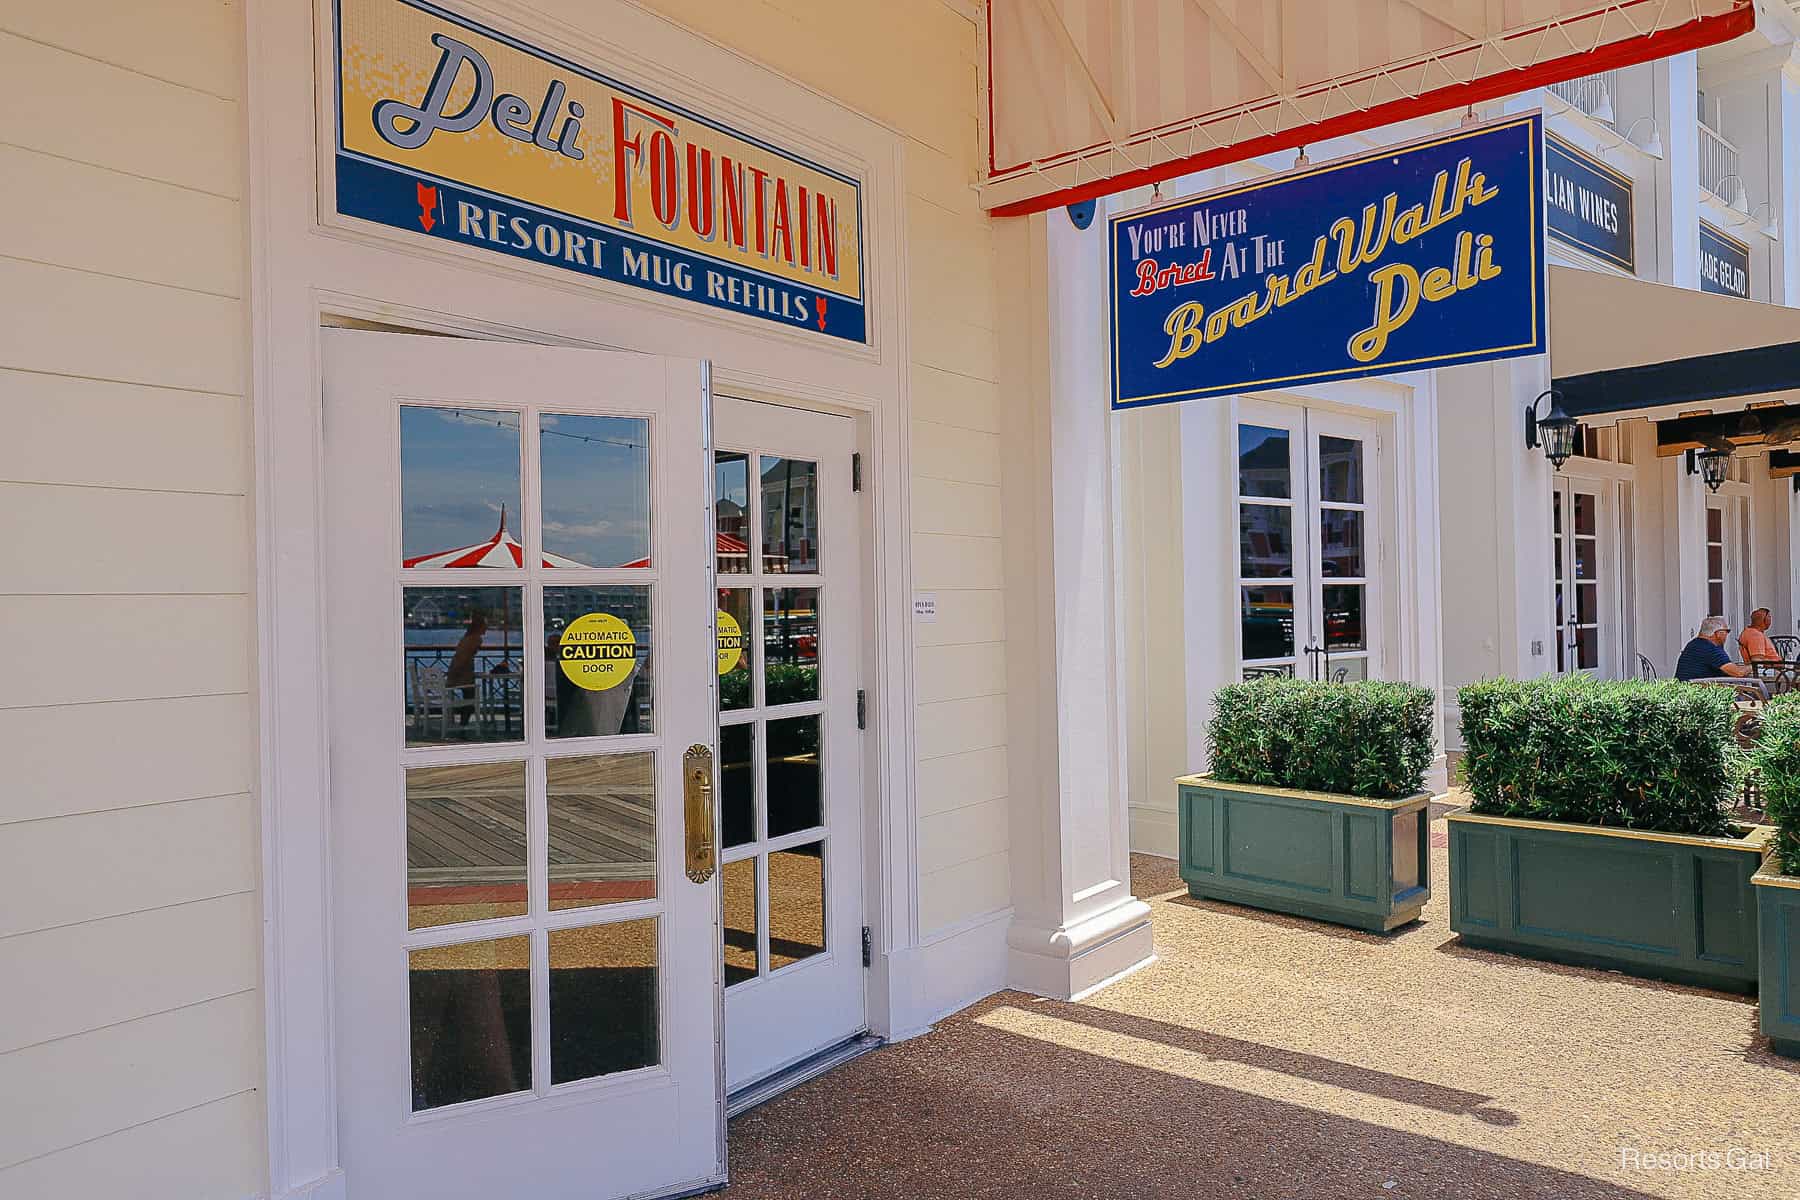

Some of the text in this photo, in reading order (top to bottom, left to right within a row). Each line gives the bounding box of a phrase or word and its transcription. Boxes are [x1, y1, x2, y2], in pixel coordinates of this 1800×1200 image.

[372, 32, 585, 161] Deli
[611, 96, 840, 282] FOUNTAIN
[1579, 186, 1618, 234] WINES
[1193, 208, 1247, 249] NEVER
[458, 200, 809, 322] RESORT MUG REFILLS
[1129, 247, 1216, 298] Bored
[1250, 234, 1285, 274] THE
[1719, 260, 1746, 297] GELATO
[1347, 231, 1502, 362] Deli
[562, 644, 634, 660] CAUTION
[567, 631, 629, 641] AUTOMATIC
[582, 664, 614, 673] DOOR
